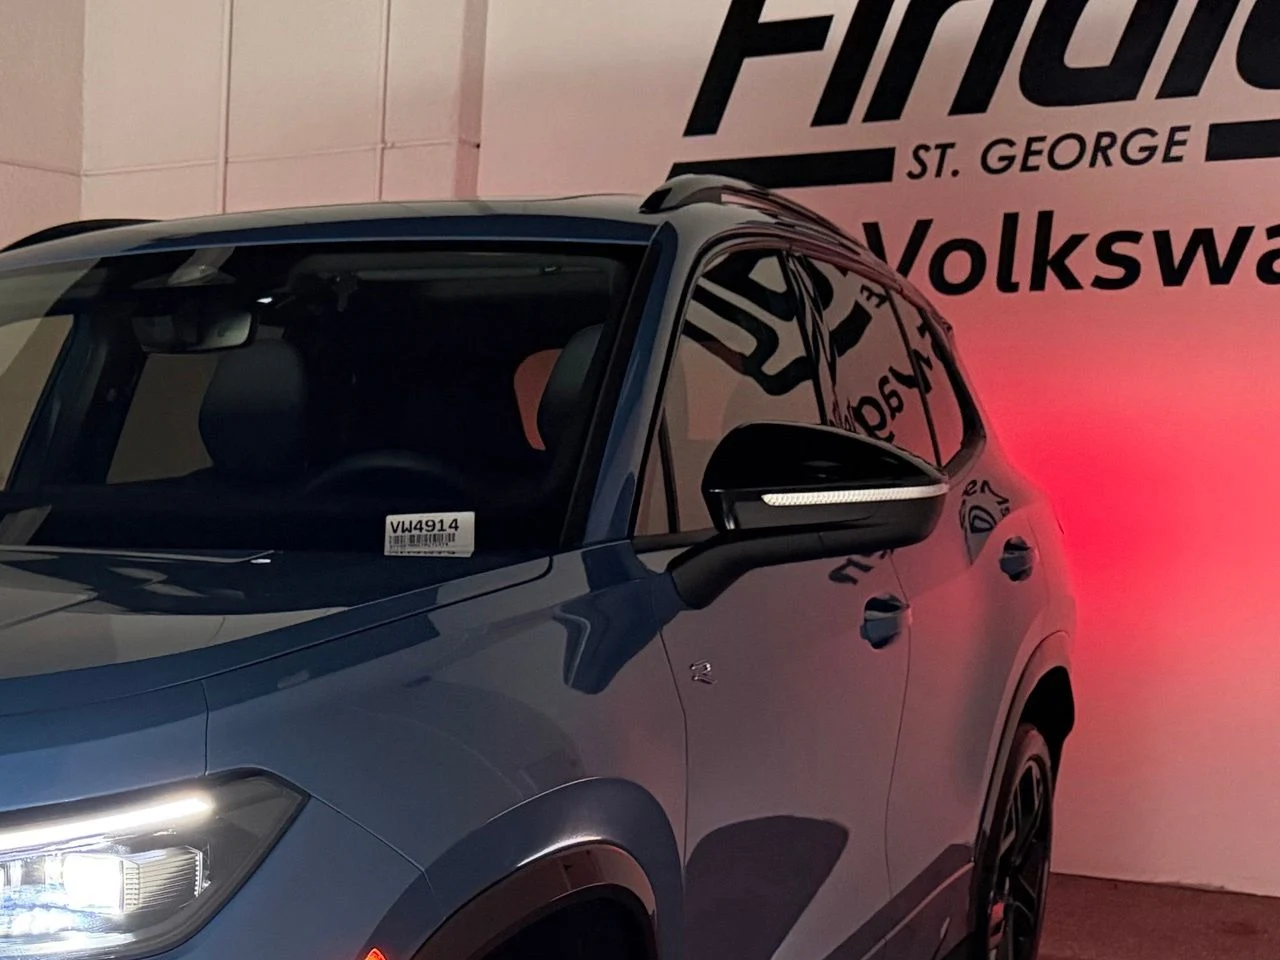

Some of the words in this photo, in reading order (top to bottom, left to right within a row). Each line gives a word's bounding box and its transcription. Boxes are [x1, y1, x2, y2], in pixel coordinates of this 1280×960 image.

[906, 142, 960, 180] ST.
[980, 125, 1191, 175] GEORGE
[390, 518, 460, 534] VW4914
